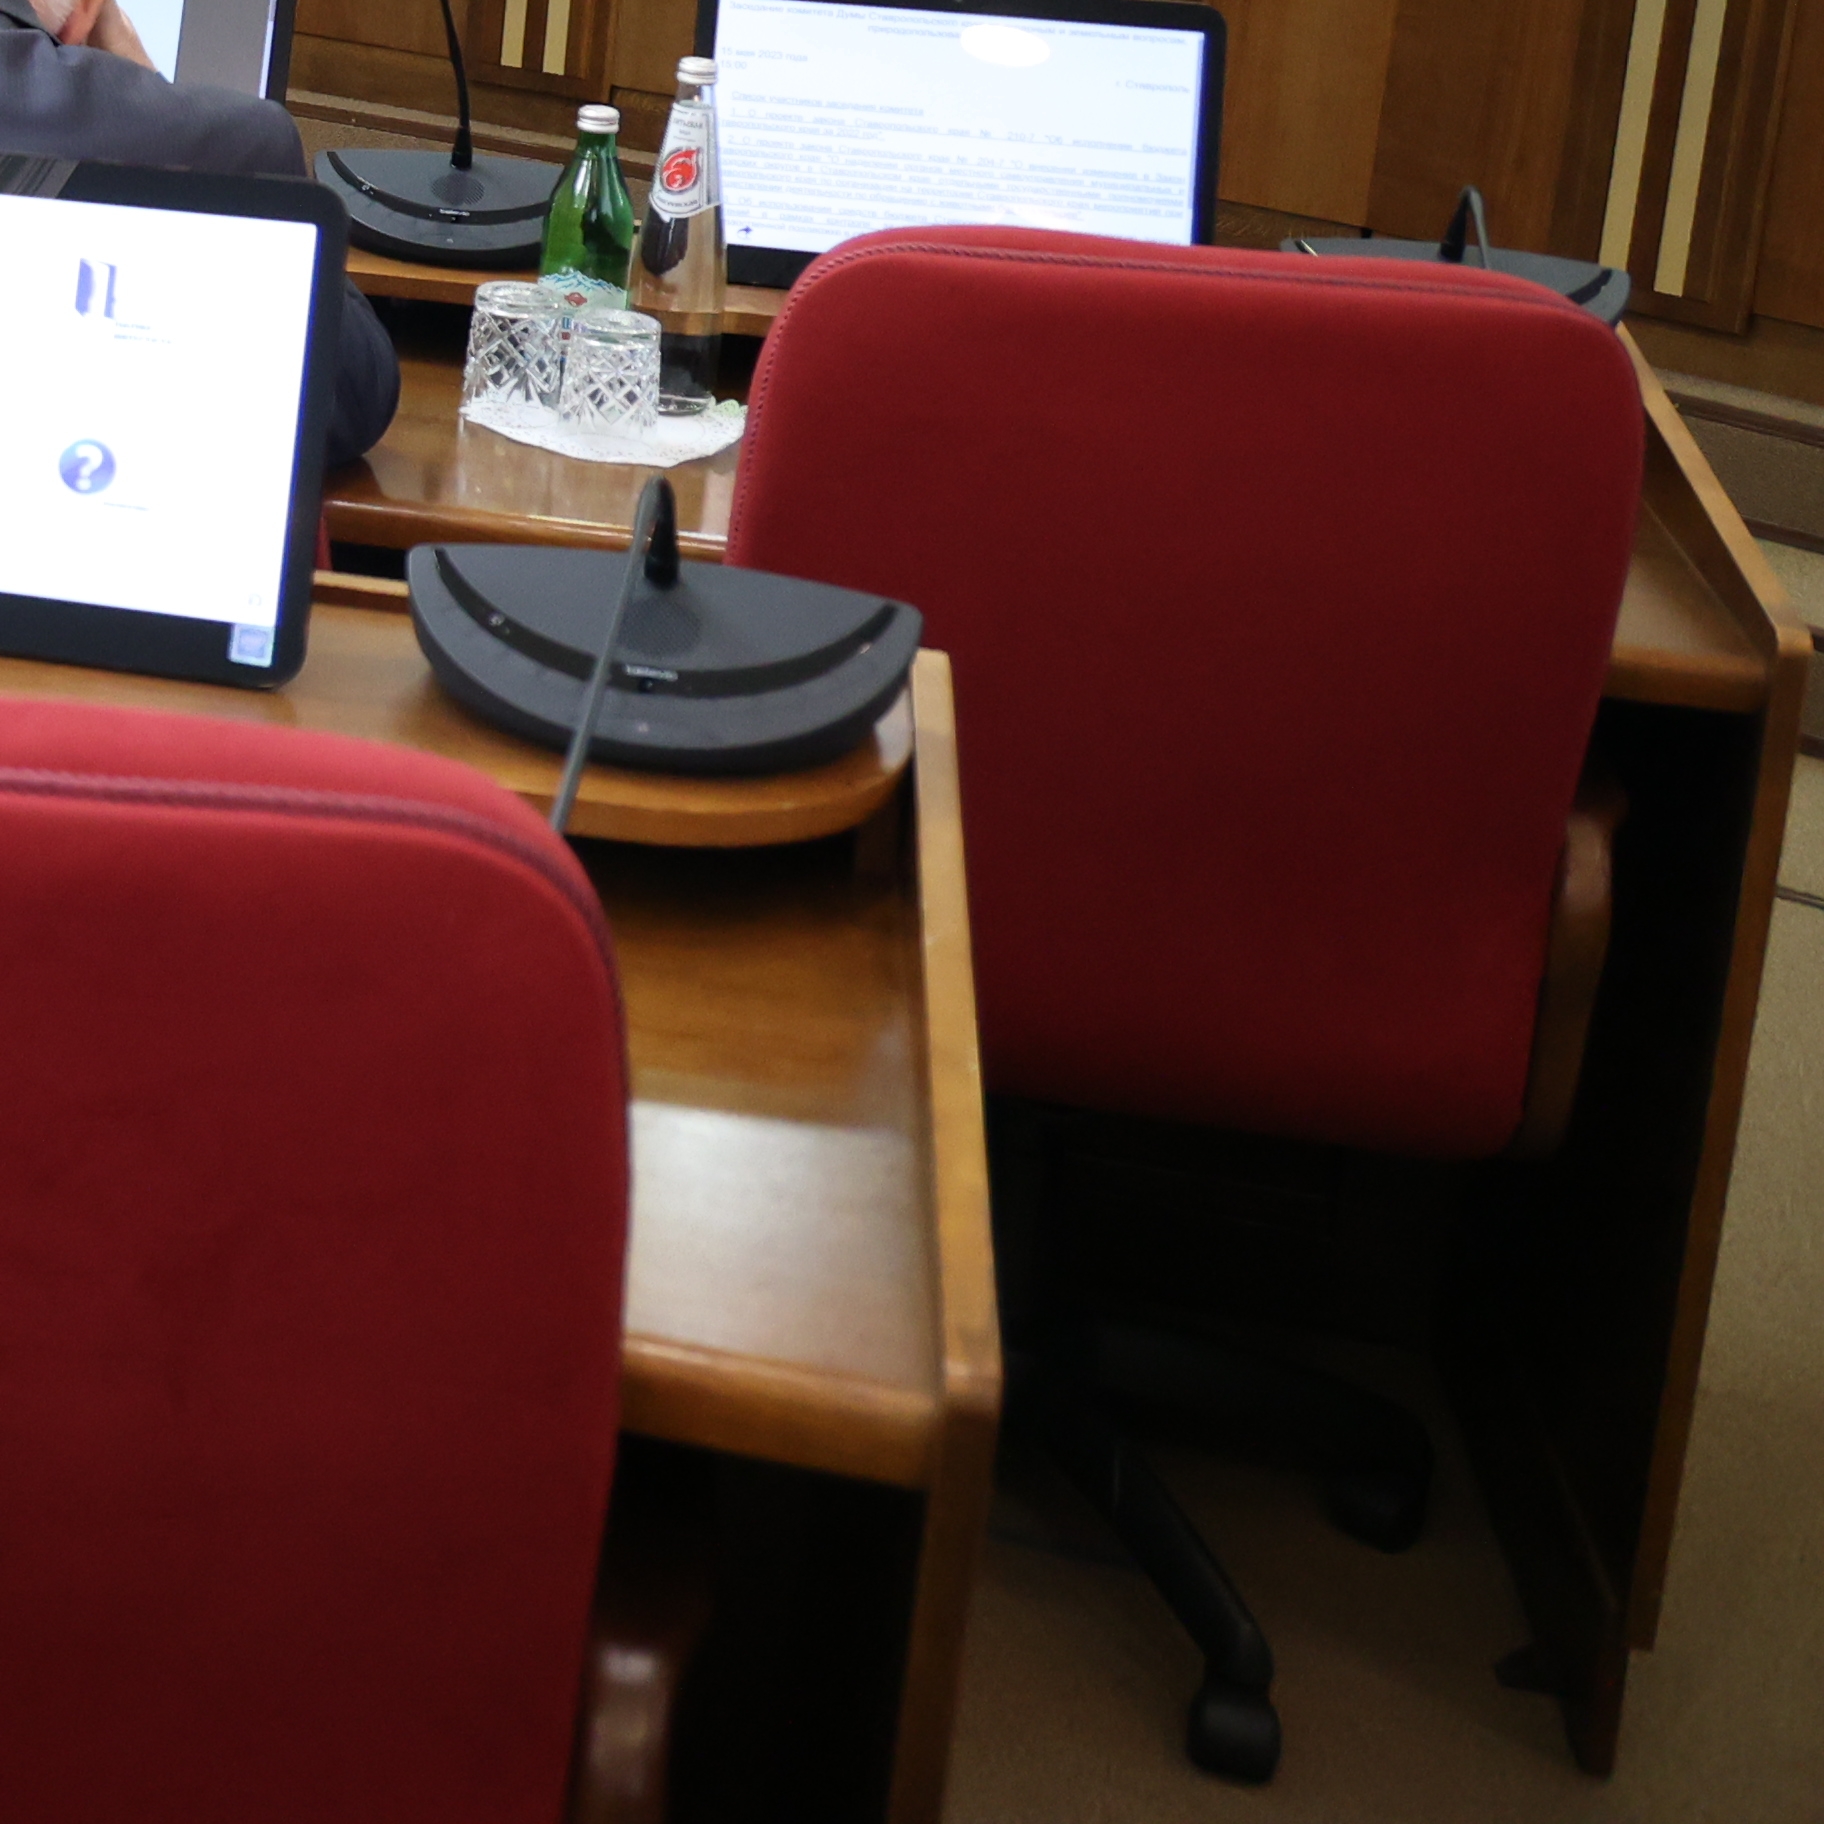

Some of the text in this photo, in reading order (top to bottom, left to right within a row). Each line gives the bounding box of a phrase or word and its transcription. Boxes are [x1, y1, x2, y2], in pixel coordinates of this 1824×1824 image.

[836, 10, 865, 19] Думы
[758, 50, 782, 59] 2023
[785, 53, 807, 62] года
[721, 118, 794, 132] тавропольского
